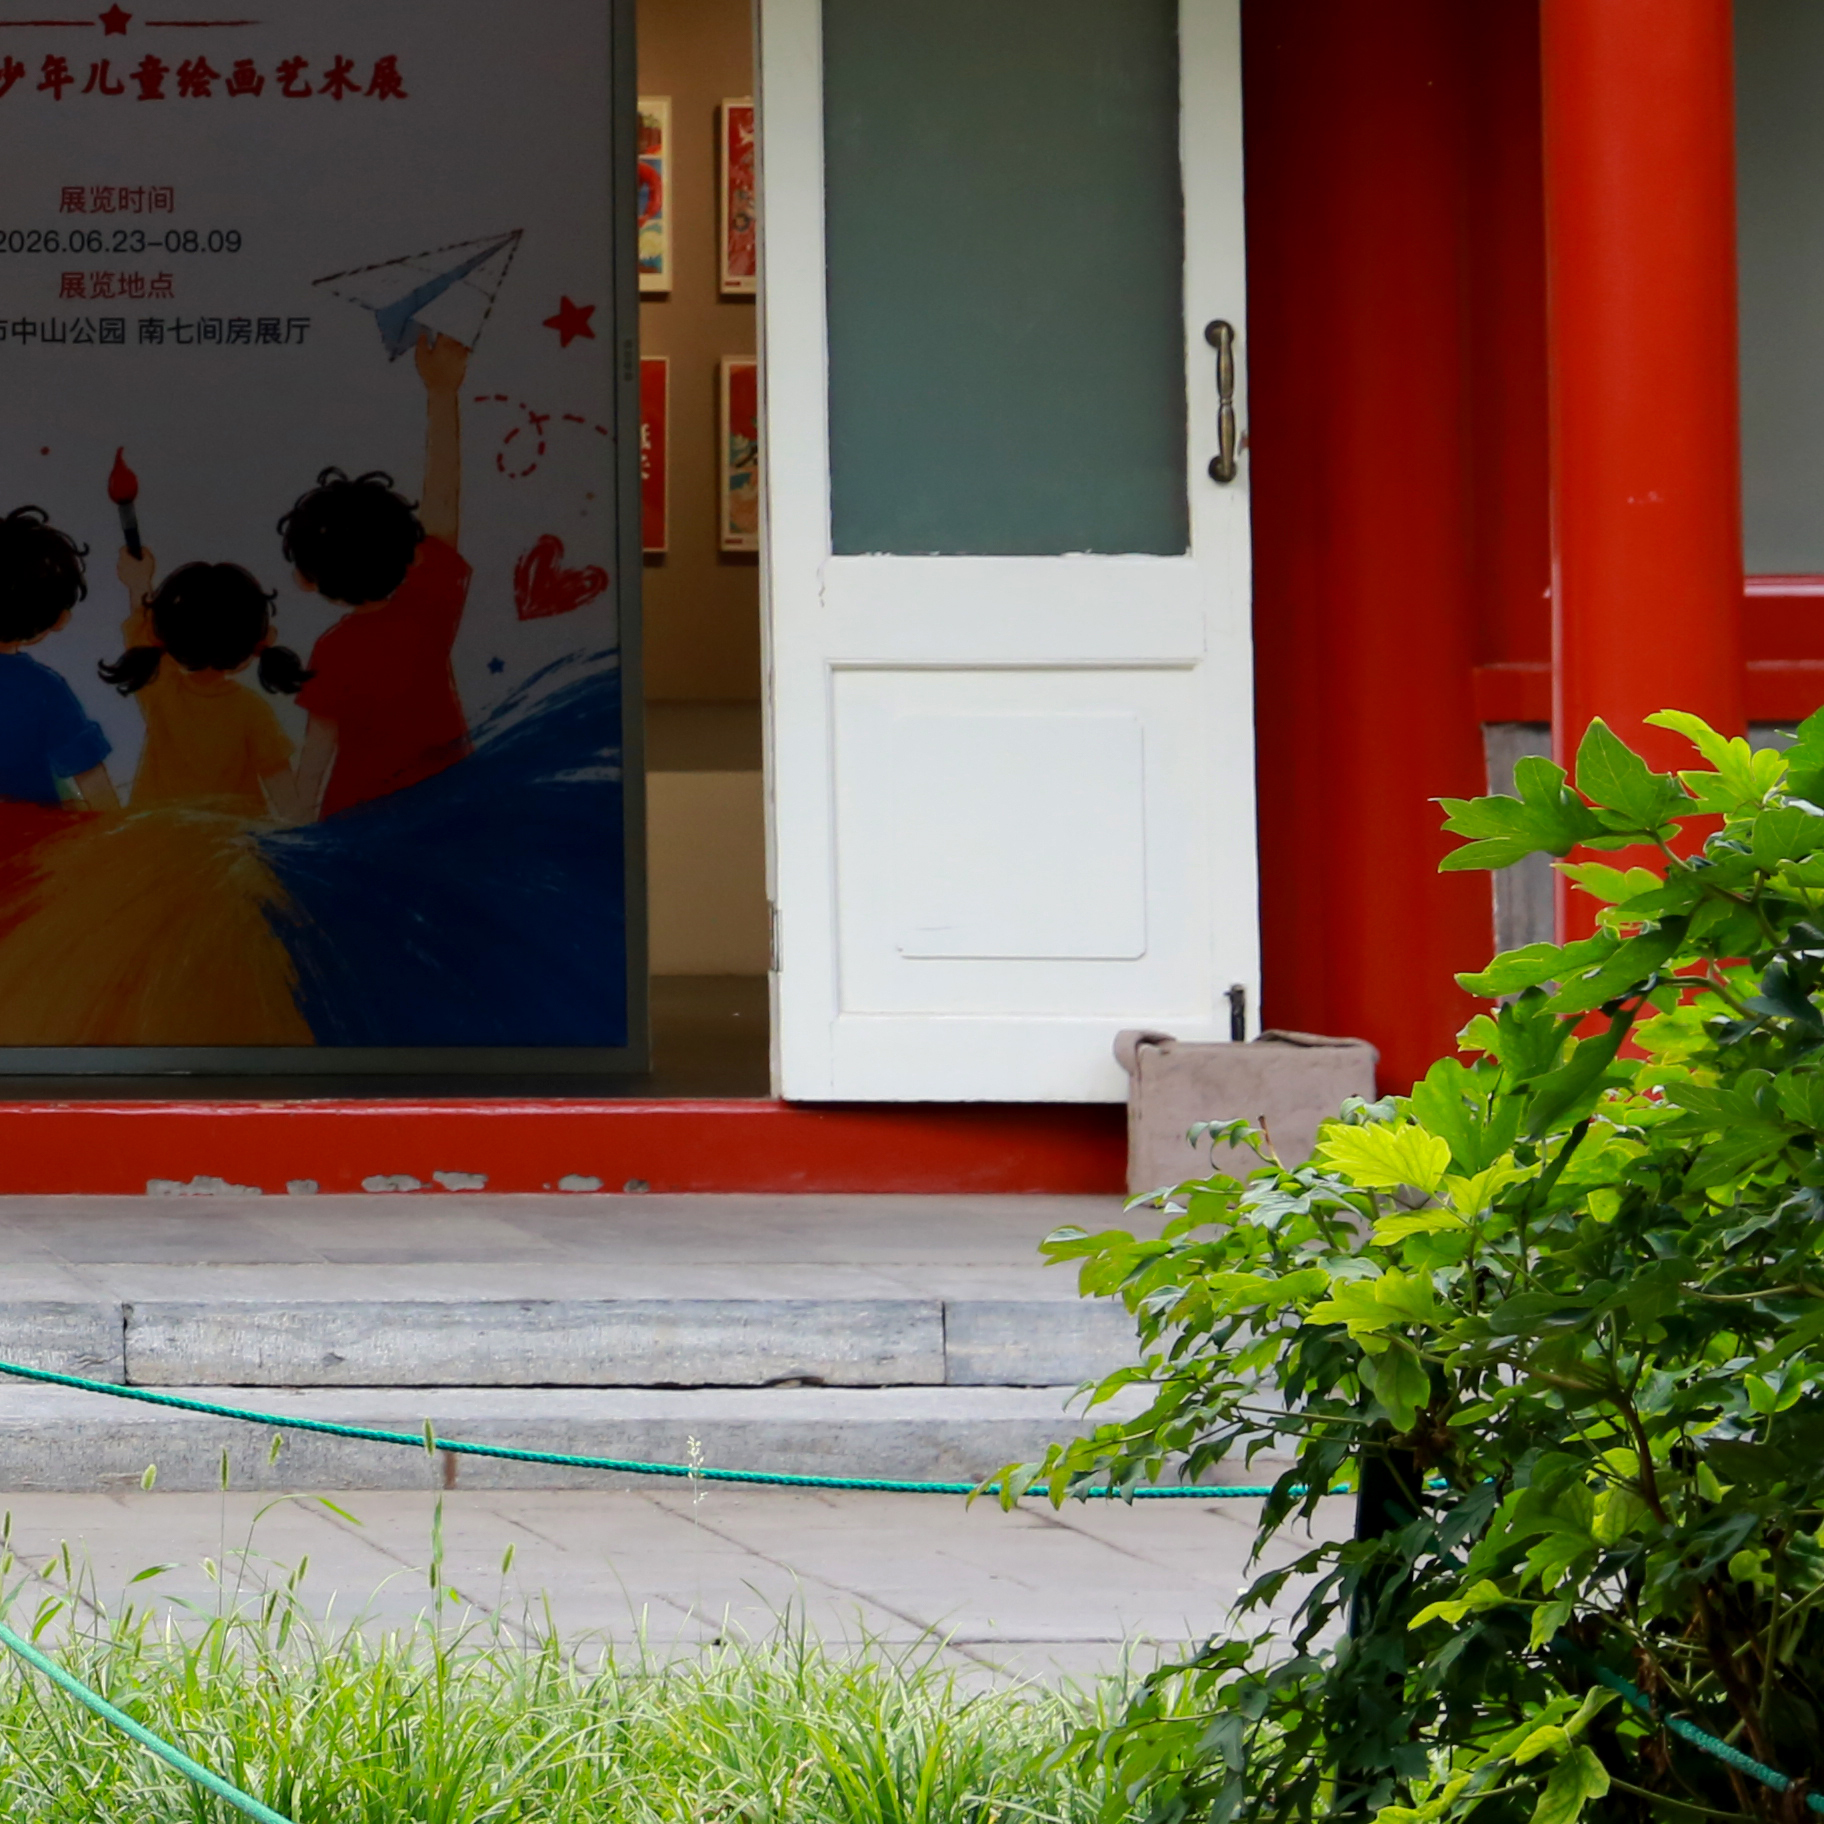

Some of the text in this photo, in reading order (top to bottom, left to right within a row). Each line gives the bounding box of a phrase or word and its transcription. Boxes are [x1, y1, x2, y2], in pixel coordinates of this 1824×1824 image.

[59, 186, 175, 214] 展览时间
[59, 272, 176, 299] 展览地点
[138, 317, 311, 346] 南七间房展厅
